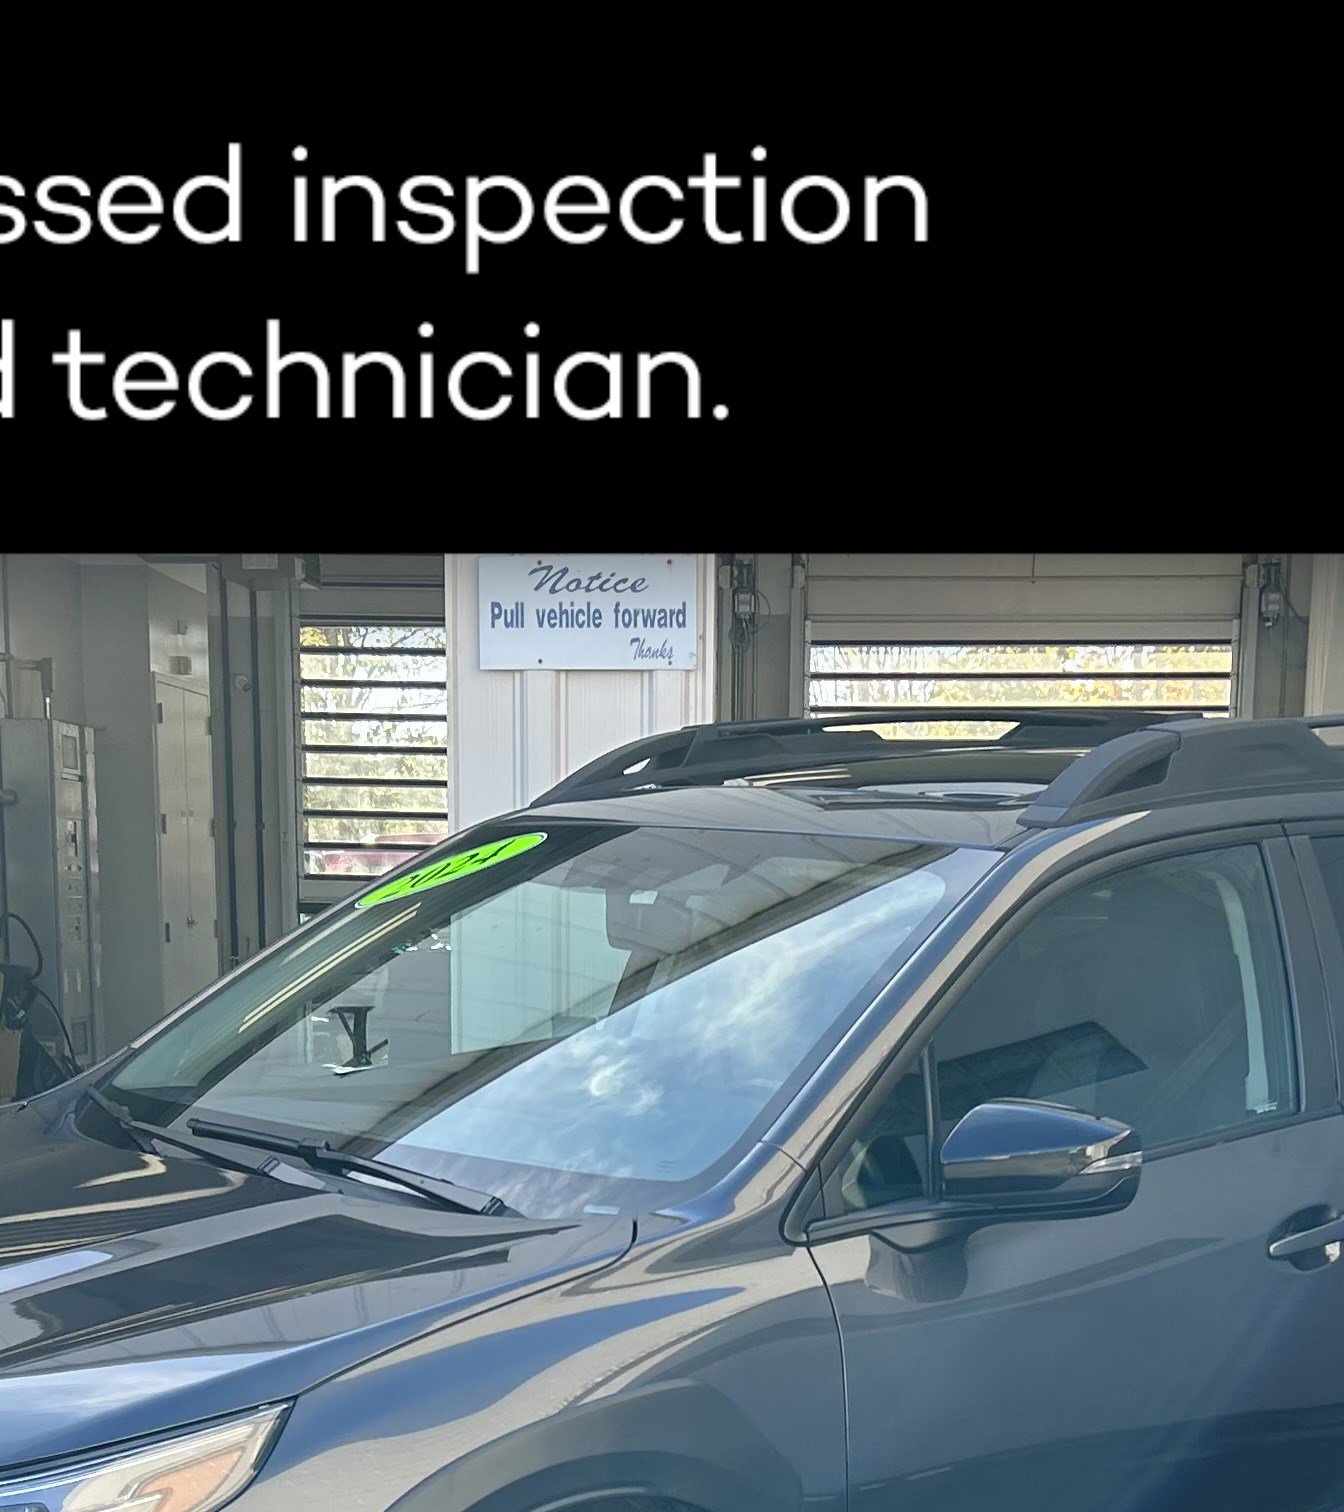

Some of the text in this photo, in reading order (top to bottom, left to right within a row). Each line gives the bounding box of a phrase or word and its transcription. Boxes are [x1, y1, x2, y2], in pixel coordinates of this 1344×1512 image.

[528, 564, 649, 595] Notice
[490, 601, 687, 629] Pull vehicle forward
[629, 637, 674, 661] Thanks
